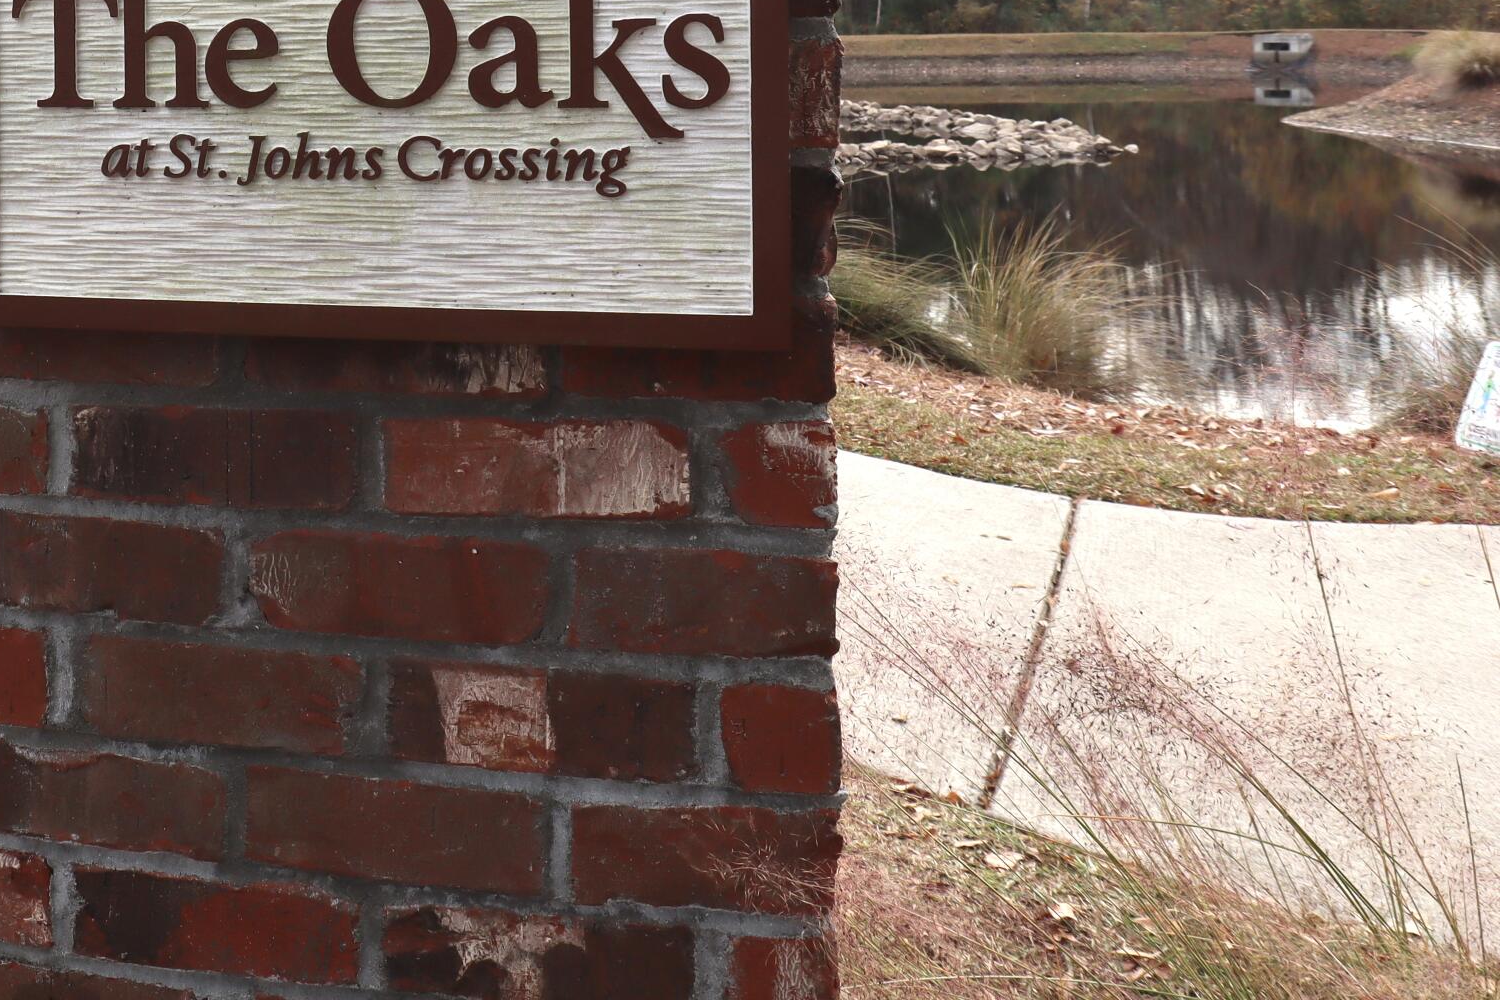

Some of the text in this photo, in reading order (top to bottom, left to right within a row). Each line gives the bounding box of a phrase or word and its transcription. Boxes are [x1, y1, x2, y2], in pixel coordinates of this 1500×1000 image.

[101, 131, 632, 198] at St. Johns Crossing
